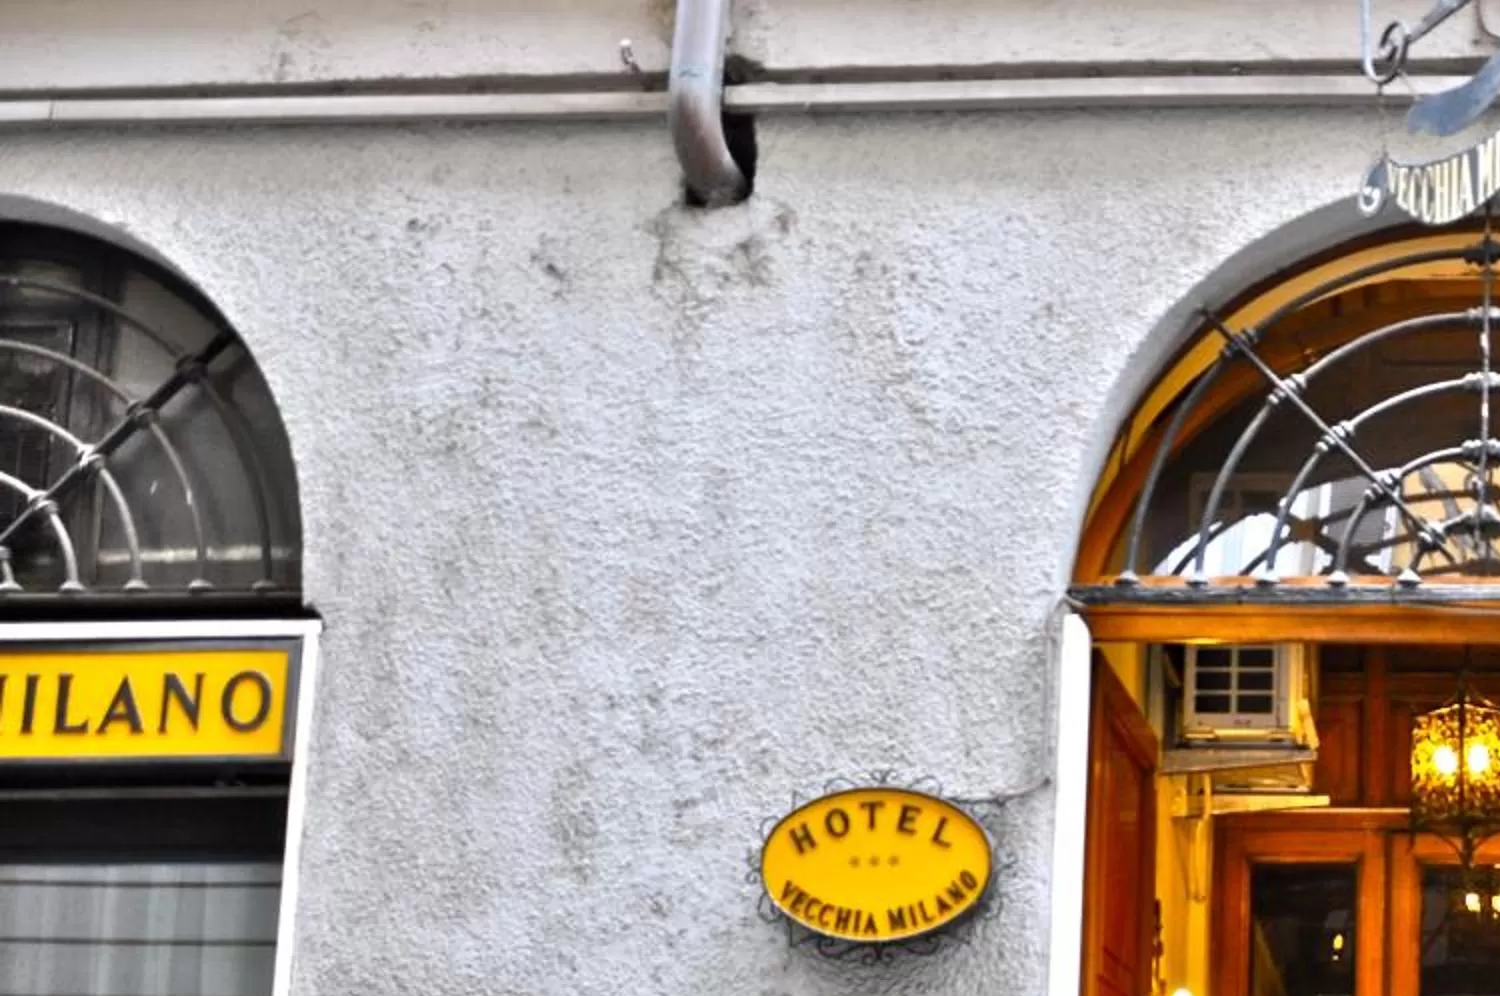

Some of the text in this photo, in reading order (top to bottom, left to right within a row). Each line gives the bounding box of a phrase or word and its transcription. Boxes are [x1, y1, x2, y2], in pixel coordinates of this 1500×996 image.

[1387, 153, 1475, 224] VECCHIA
[0, 670, 272, 736] ILANO
[788, 800, 952, 855] HOTEL
[779, 869, 978, 935] VECCHIA MILANO
